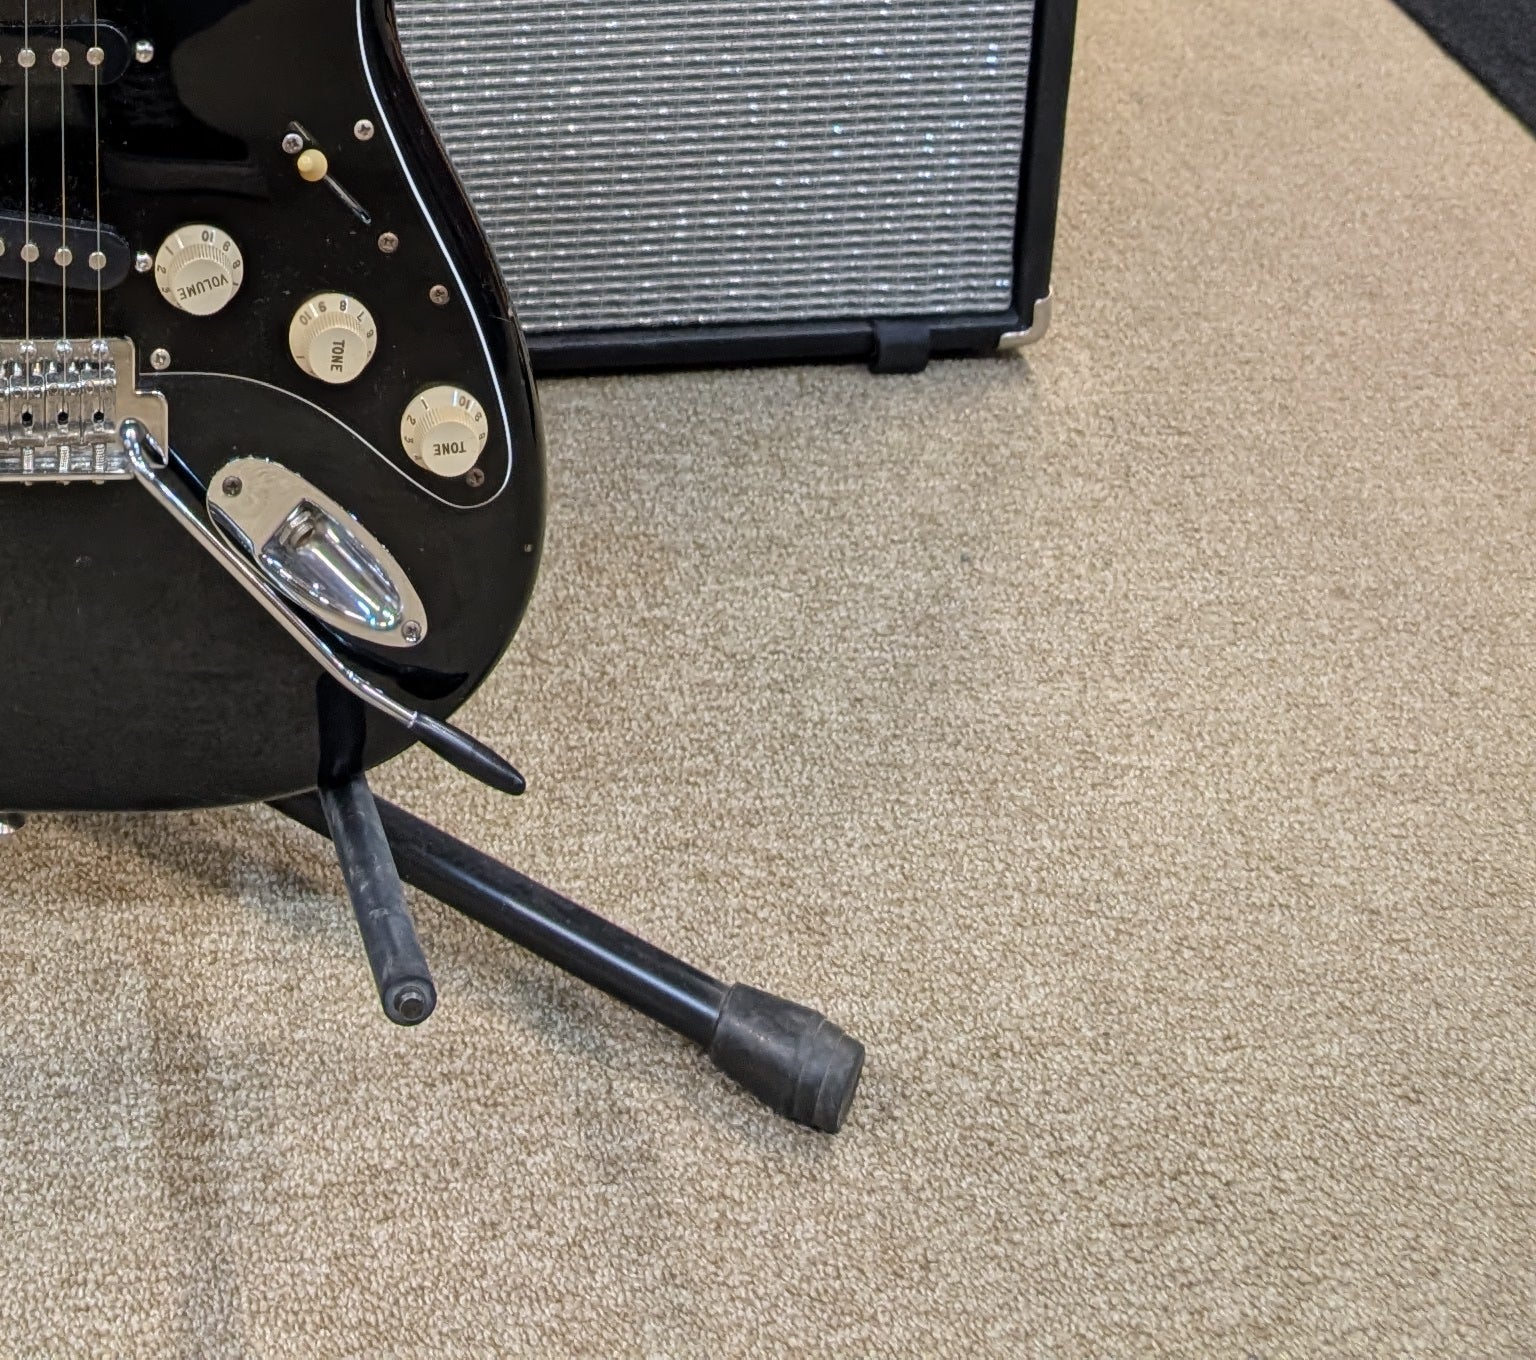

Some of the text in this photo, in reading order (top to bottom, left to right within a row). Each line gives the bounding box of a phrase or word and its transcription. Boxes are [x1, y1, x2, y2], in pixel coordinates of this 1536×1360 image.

[177, 273, 229, 301] VOLUME
[330, 340, 346, 373] TONE
[433, 440, 467, 456] TONE
